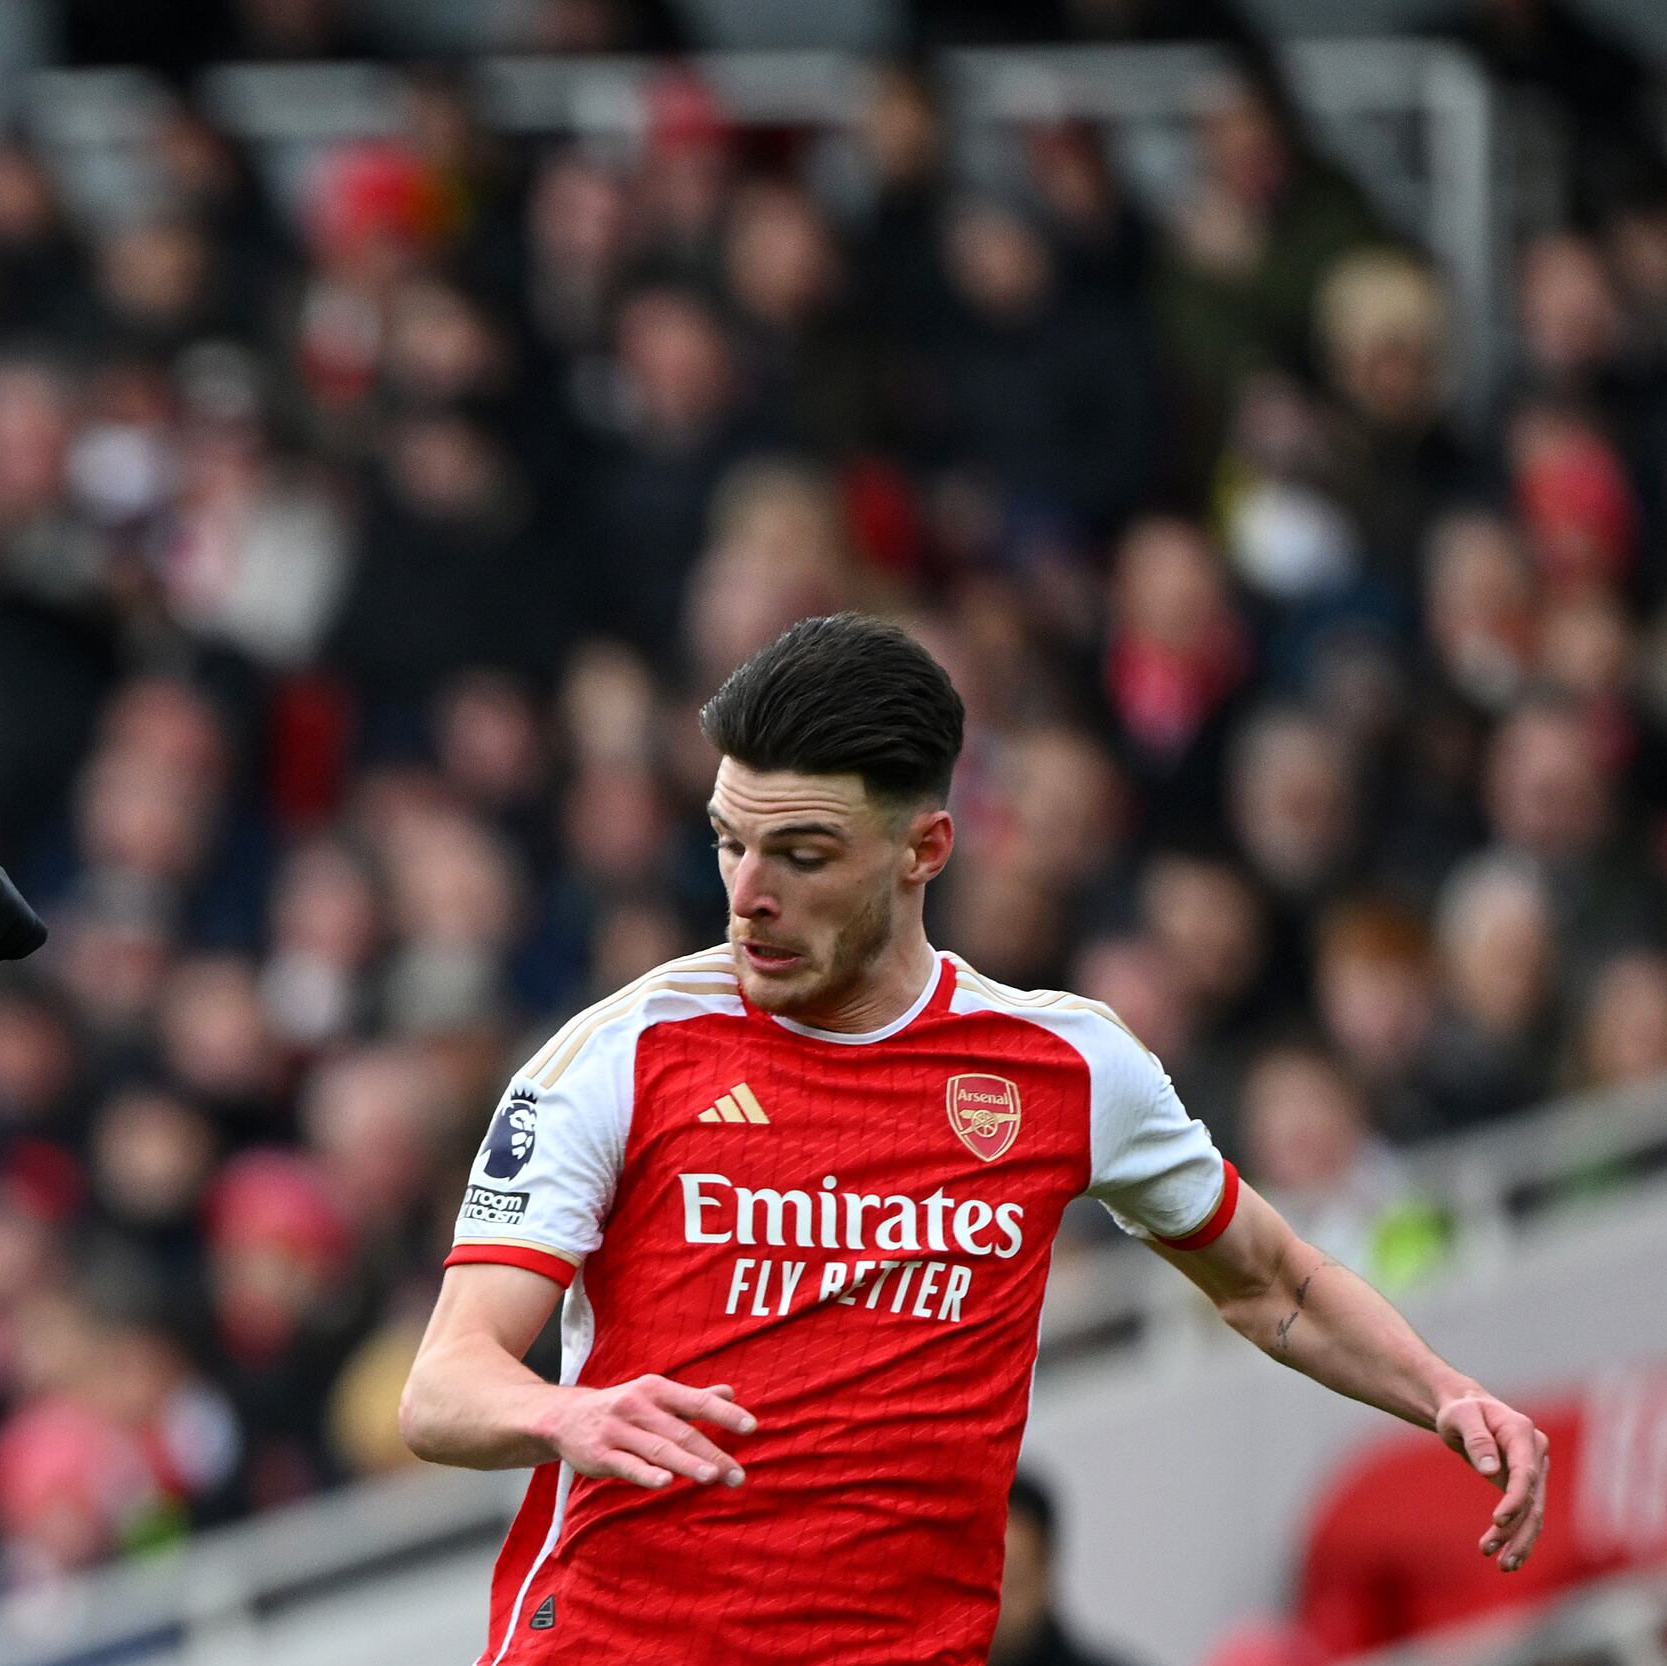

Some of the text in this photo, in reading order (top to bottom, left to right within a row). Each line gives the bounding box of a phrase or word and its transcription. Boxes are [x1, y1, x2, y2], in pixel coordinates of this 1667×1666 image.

[958, 1089, 1010, 1105] Arsenal
[471, 1189, 522, 1211] room
[465, 1203, 524, 1225] racism
[678, 1173, 1024, 1259] Emirates
[725, 1258, 973, 1323] FLY BETTER
